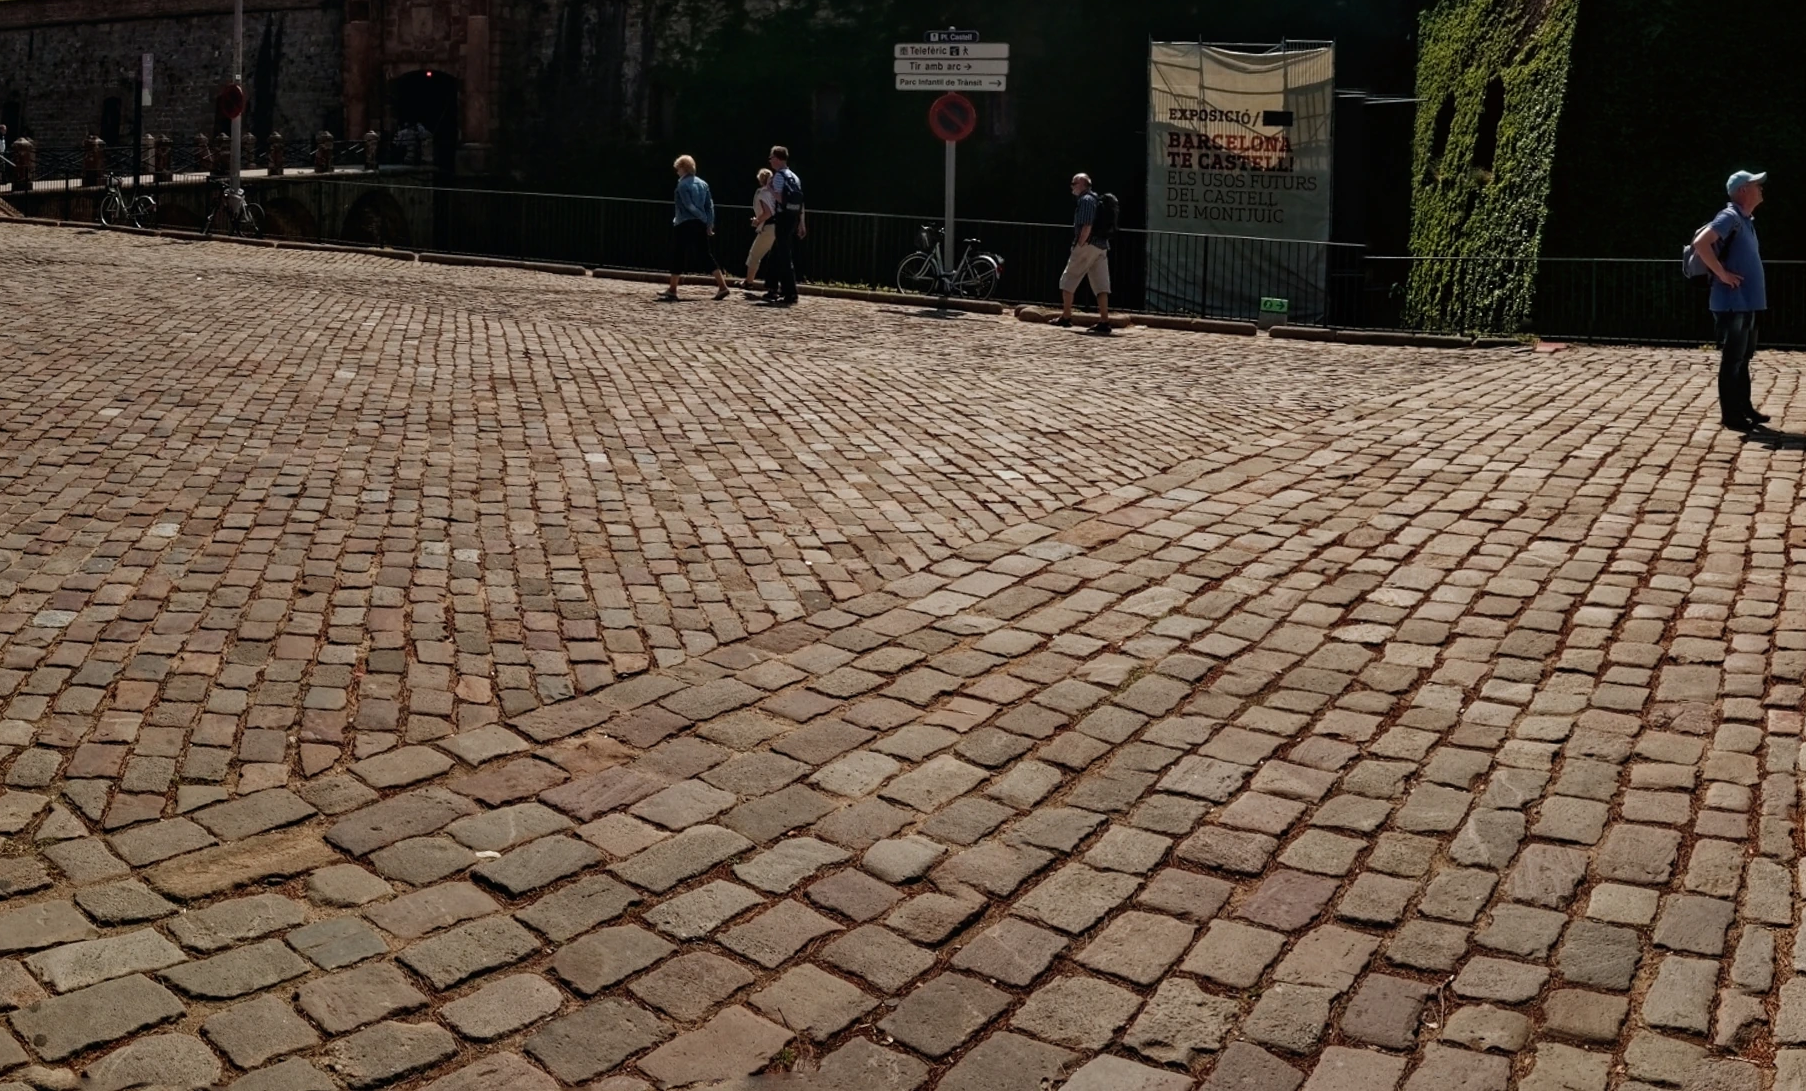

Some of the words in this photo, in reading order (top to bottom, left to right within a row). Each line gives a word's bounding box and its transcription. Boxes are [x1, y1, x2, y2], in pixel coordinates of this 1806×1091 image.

[910, 61, 922, 71] Tir
[925, 62, 943, 71] amb
[947, 63, 961, 71] arc
[899, 78, 916, 86] Parc
[918, 78, 944, 86] Infantil
[1168, 132, 1293, 153] BARCELONA
[1198, 154, 1294, 172] CASTELL!
[1167, 171, 1197, 186] ELS
[1201, 173, 1245, 188] USOS
[1250, 174, 1318, 191] FUTURS
[1167, 188, 1199, 202] DEL
[1203, 189, 1279, 207] CASTELL
[1167, 205, 1189, 218] DE
